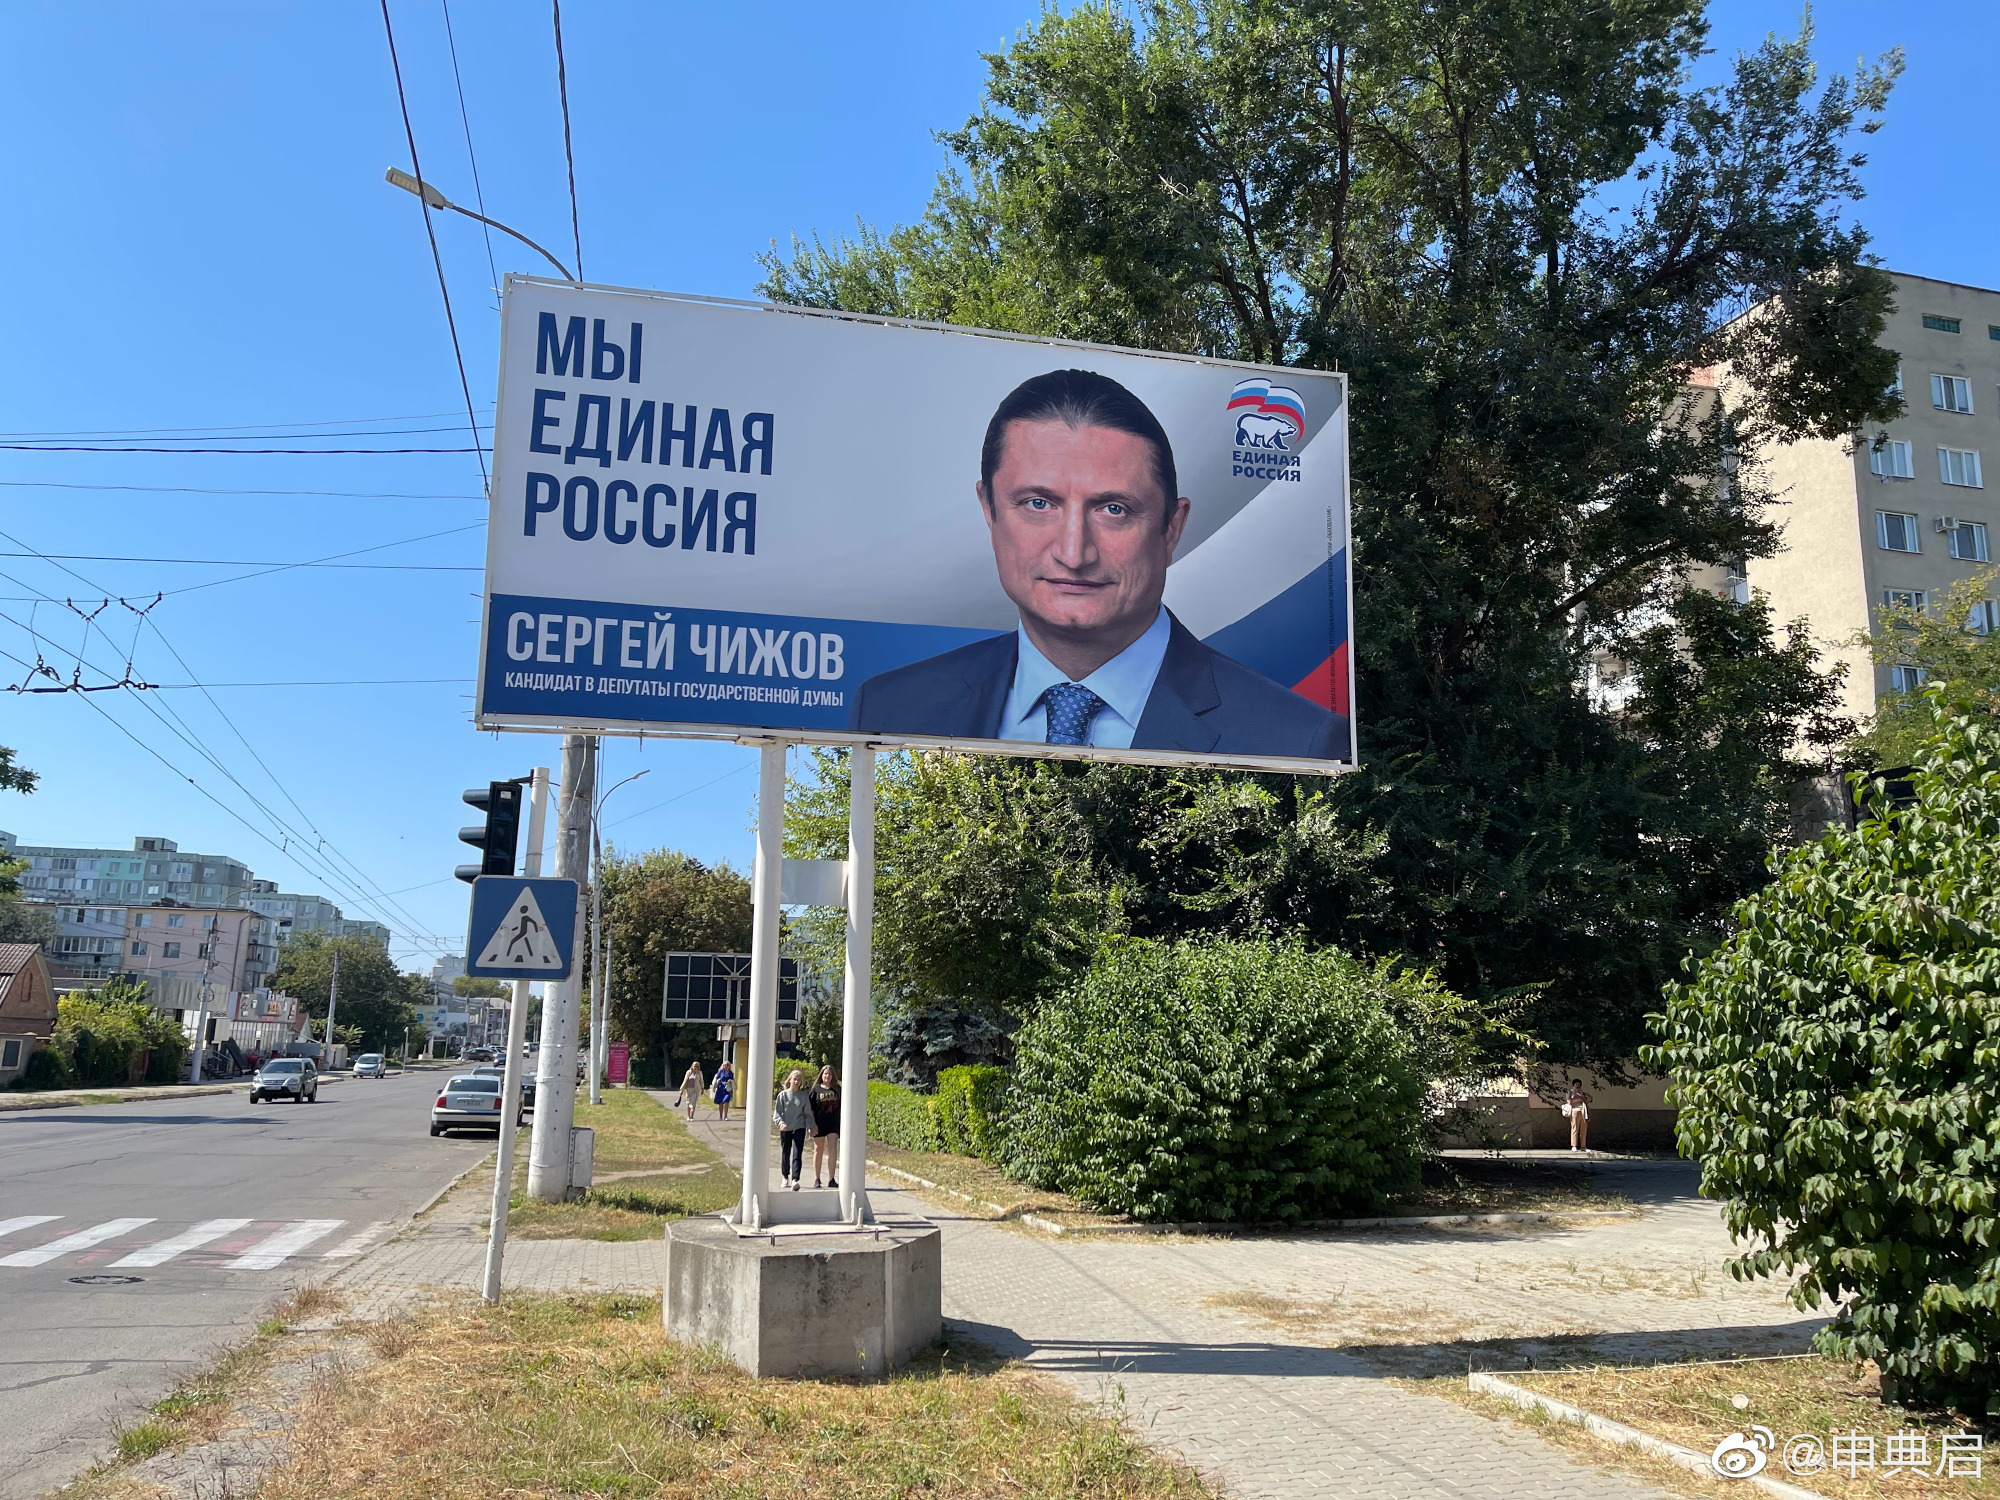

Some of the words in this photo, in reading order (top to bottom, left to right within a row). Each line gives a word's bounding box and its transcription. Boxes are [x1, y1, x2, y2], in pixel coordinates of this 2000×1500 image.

[535, 311, 643, 384] МЫ
[529, 388, 775, 476] ЕДИНАЯ
[1232, 450, 1301, 467] ЕДИНАЯ
[1232, 464, 1301, 482] РОССИЯ
[523, 471, 757, 556] РОССИЯ
[506, 611, 677, 671] СЕРГЕЙ
[688, 624, 845, 681] ЧИЖОВ
[504, 671, 583, 693] КАНДИДАТ
[585, 675, 595, 692] В
[597, 677, 671, 698] ДЕПУТАТЫ
[673, 682, 800, 706] ГОСУДАРСТВЕННОЙ
[802, 689, 844, 708] ДУМЫ
